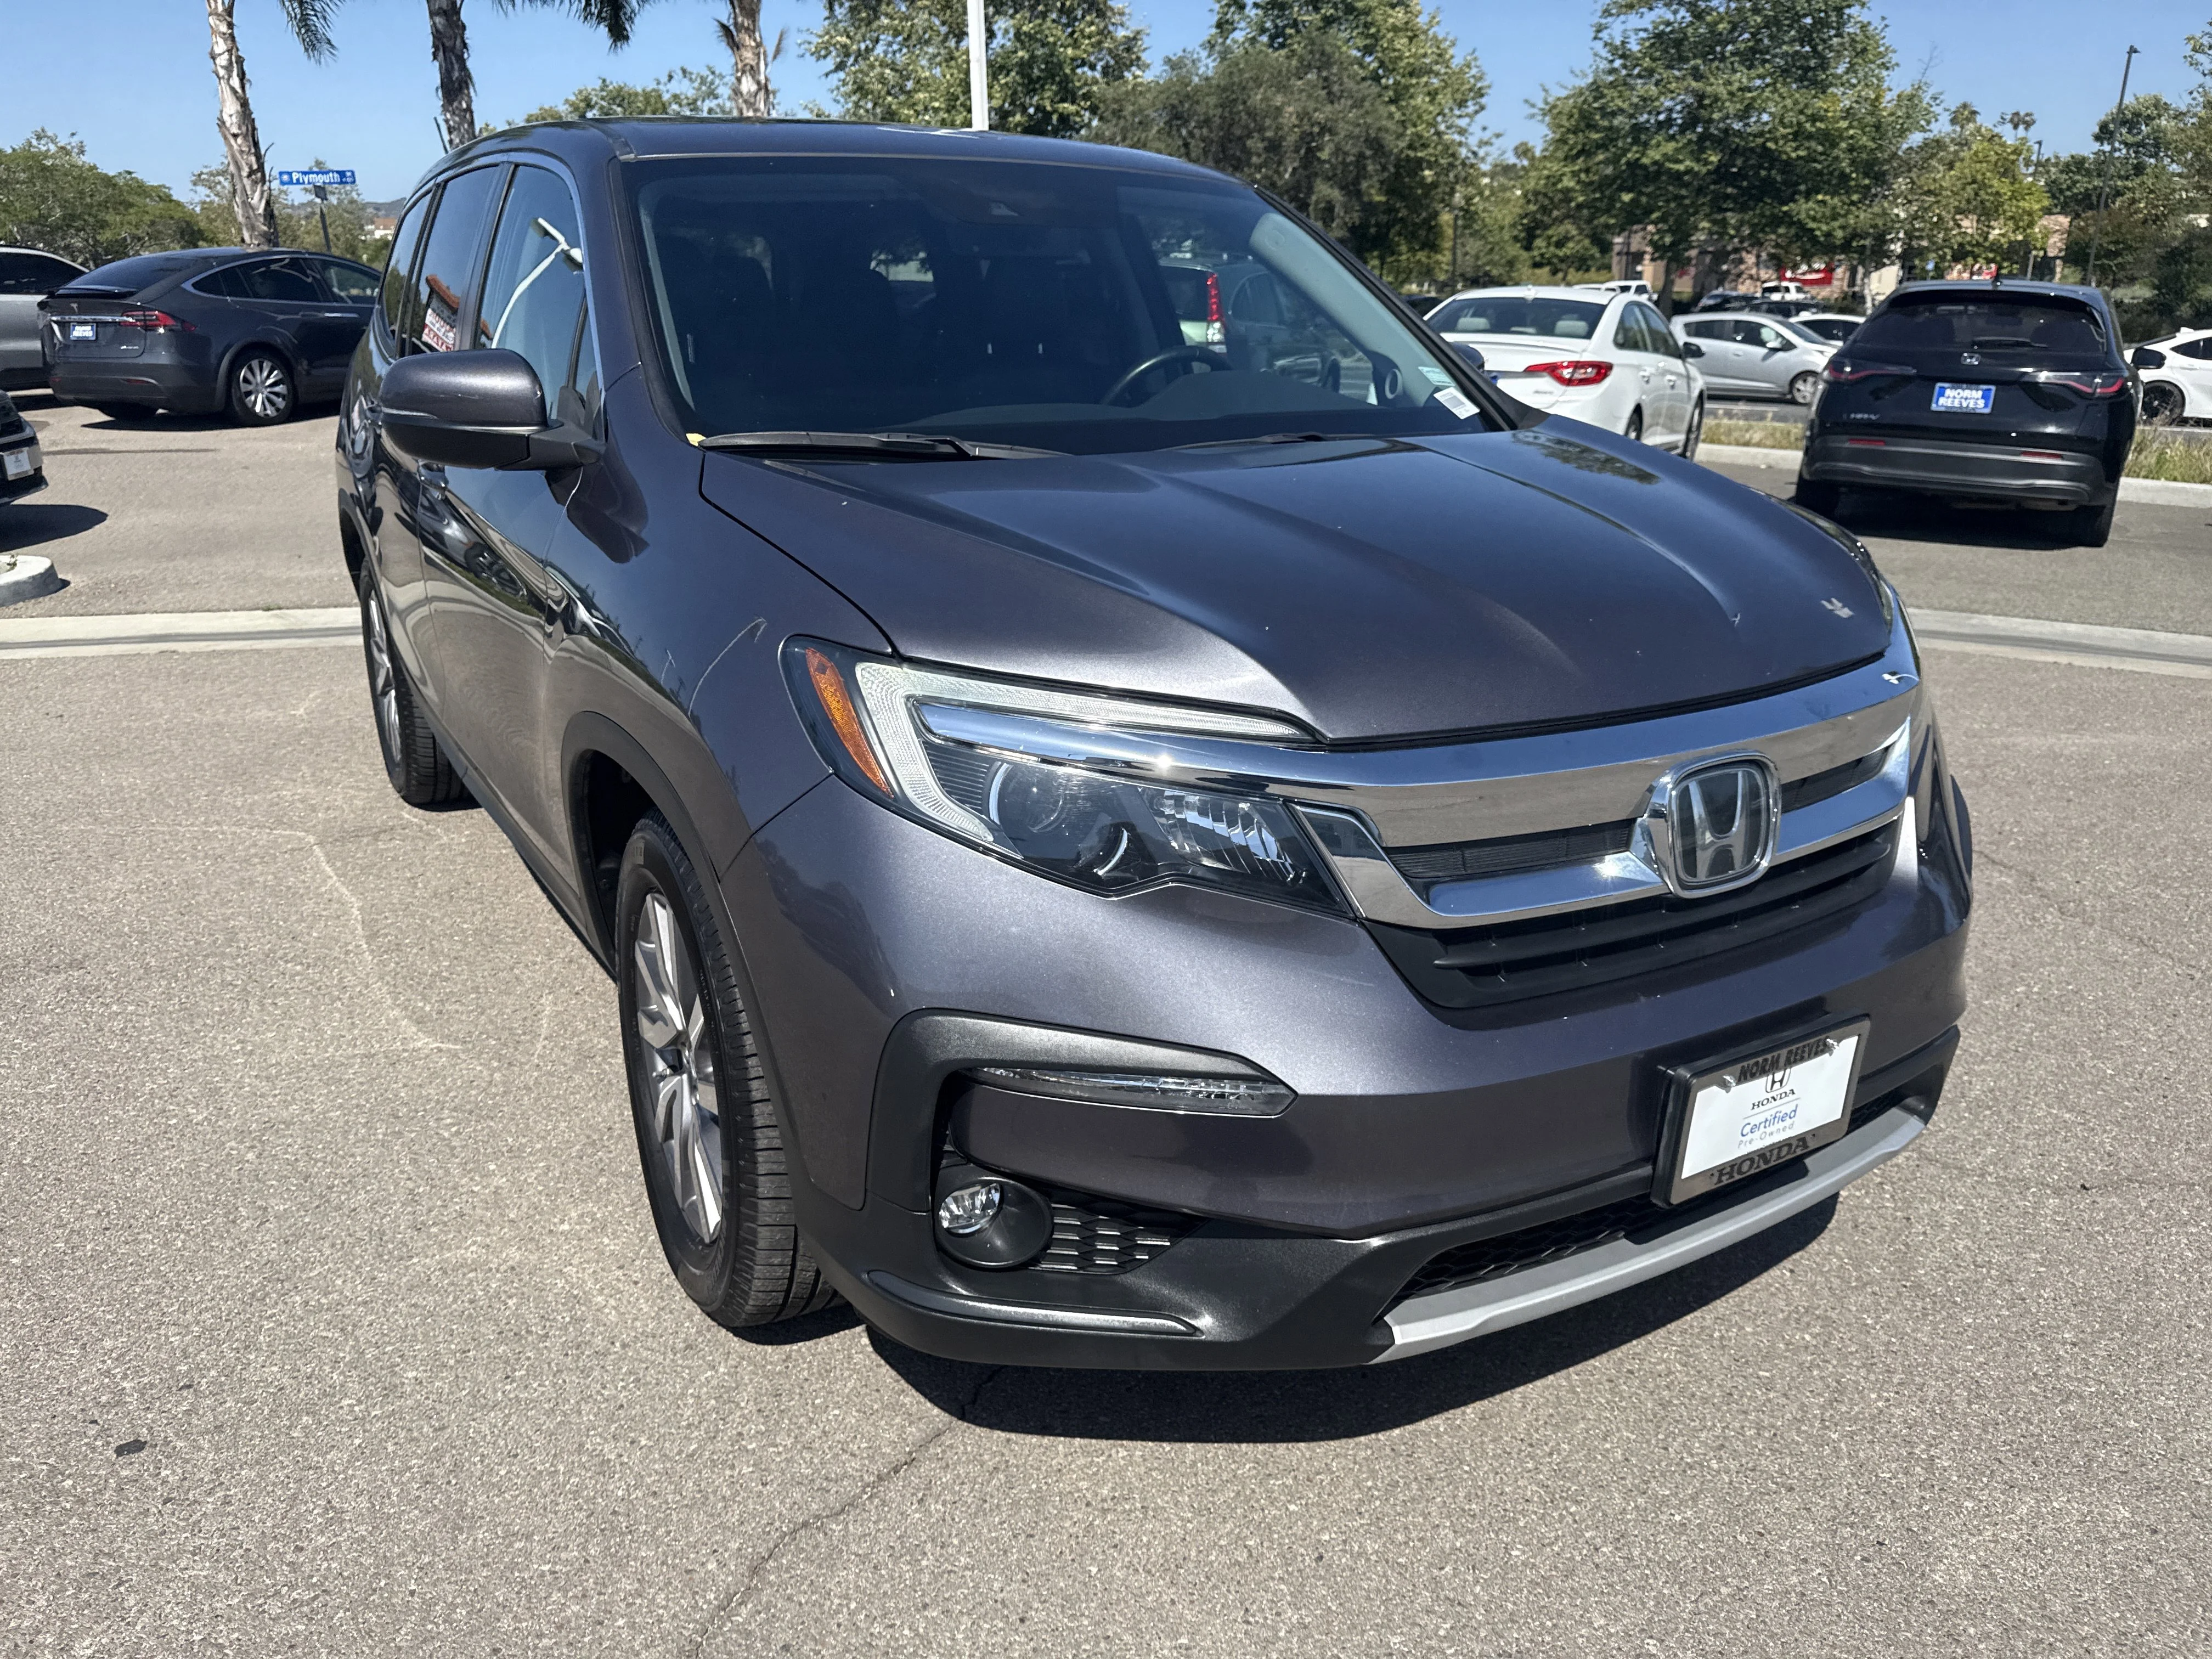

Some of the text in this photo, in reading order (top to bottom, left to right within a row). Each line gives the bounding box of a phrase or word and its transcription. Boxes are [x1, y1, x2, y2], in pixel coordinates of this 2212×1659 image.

[292, 172, 340, 184] Plymouth
[1938, 397, 1985, 408] REEVES
[1944, 388, 1983, 398] NORM
[1738, 1053, 1781, 1082] NORM
[1751, 1088, 1795, 1110] HONDA
[1741, 1104, 1798, 1137] Certified
[1737, 1121, 1795, 1149] Pre-Owned
[1714, 1137, 1809, 1185] HONDA
